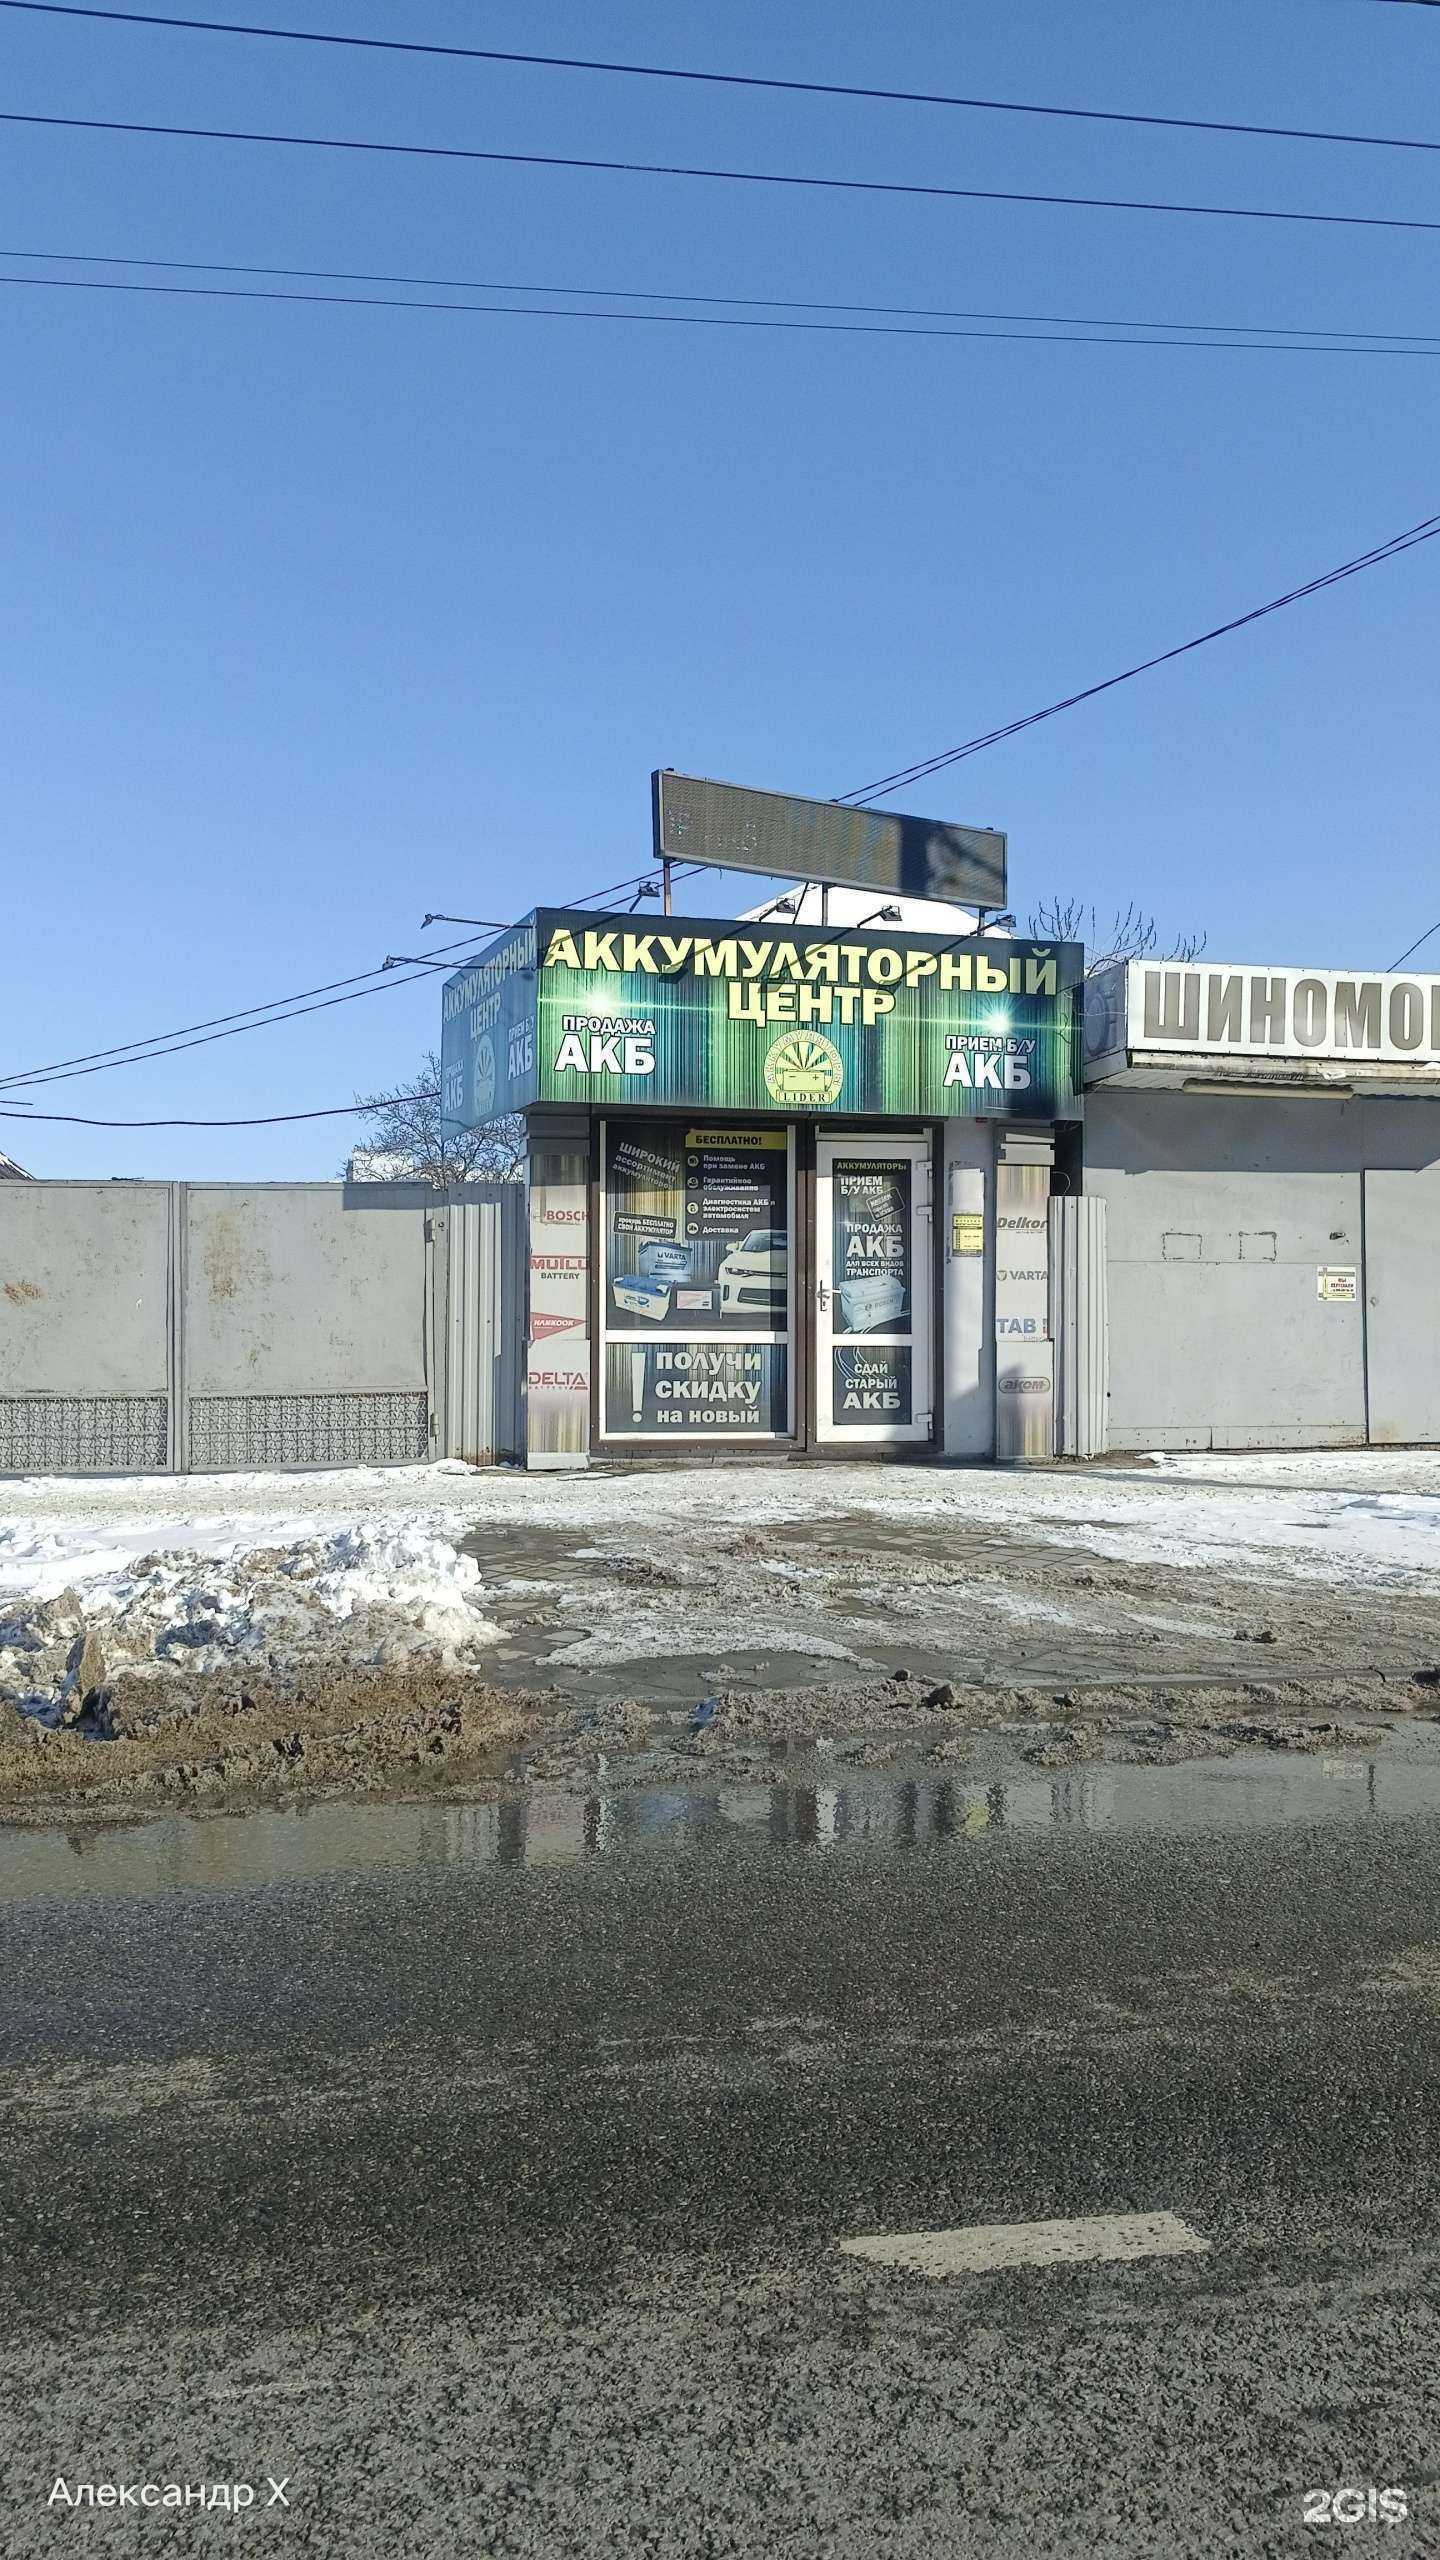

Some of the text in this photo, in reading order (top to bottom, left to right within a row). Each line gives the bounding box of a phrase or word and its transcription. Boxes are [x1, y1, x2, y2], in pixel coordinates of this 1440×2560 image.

[444, 916, 537, 1021] АККУМУЛЯТОРНЫЙ
[542, 927, 1057, 996] АККУМУЛЯТОРНЫЙ
[727, 982, 896, 1028] ЦЕНТР
[1143, 970, 1440, 1052] ШИНОМО
[470, 992, 501, 1041] ЦЕНТР
[563, 1015, 656, 1036] ПРОДАЖА
[945, 1035, 1036, 1055] ПРИЕМ Б/У
[507, 1033, 533, 1080] АКБ
[554, 1034, 656, 1075] АКБ
[943, 1053, 1032, 1090] АКБ
[783, 1092, 826, 1102] LIDER
[696, 1136, 762, 1145] БЕСПЛАТНО!
[620, 1142, 680, 1173] ШИРОКИЙ
[703, 1155, 735, 1163] Помощь
[616, 1155, 676, 1183] ассортимент
[837, 1161, 906, 1170] АККУМУЛЯТОРЫ
[840, 1175, 883, 1185] ПРИЕМ
[840, 1185, 884, 1196] Б/У АКБ
[702, 1198, 751, 1206] Диагностика
[846, 1223, 903, 1235] ПРОДАЖА
[997, 1216, 1048, 1229] Delkor
[846, 1235, 904, 1258] АКБ
[664, 1252, 686, 1260] VARTA
[845, 1260, 860, 1268] ДЛЯ
[541, 1272, 580, 1280] BATTERY
[846, 1268, 904, 1276] ТРАНСПОРТА
[1009, 1270, 1048, 1280] VARTA
[995, 1318, 1037, 1333] TAB
[854, 1360, 888, 1375] СДАЙ
[528, 1371, 587, 1385] DELTA
[845, 1375, 897, 1389] СТАРЫЙ
[842, 1392, 901, 1409] АКБ
[657, 1405, 760, 1423] на новый
